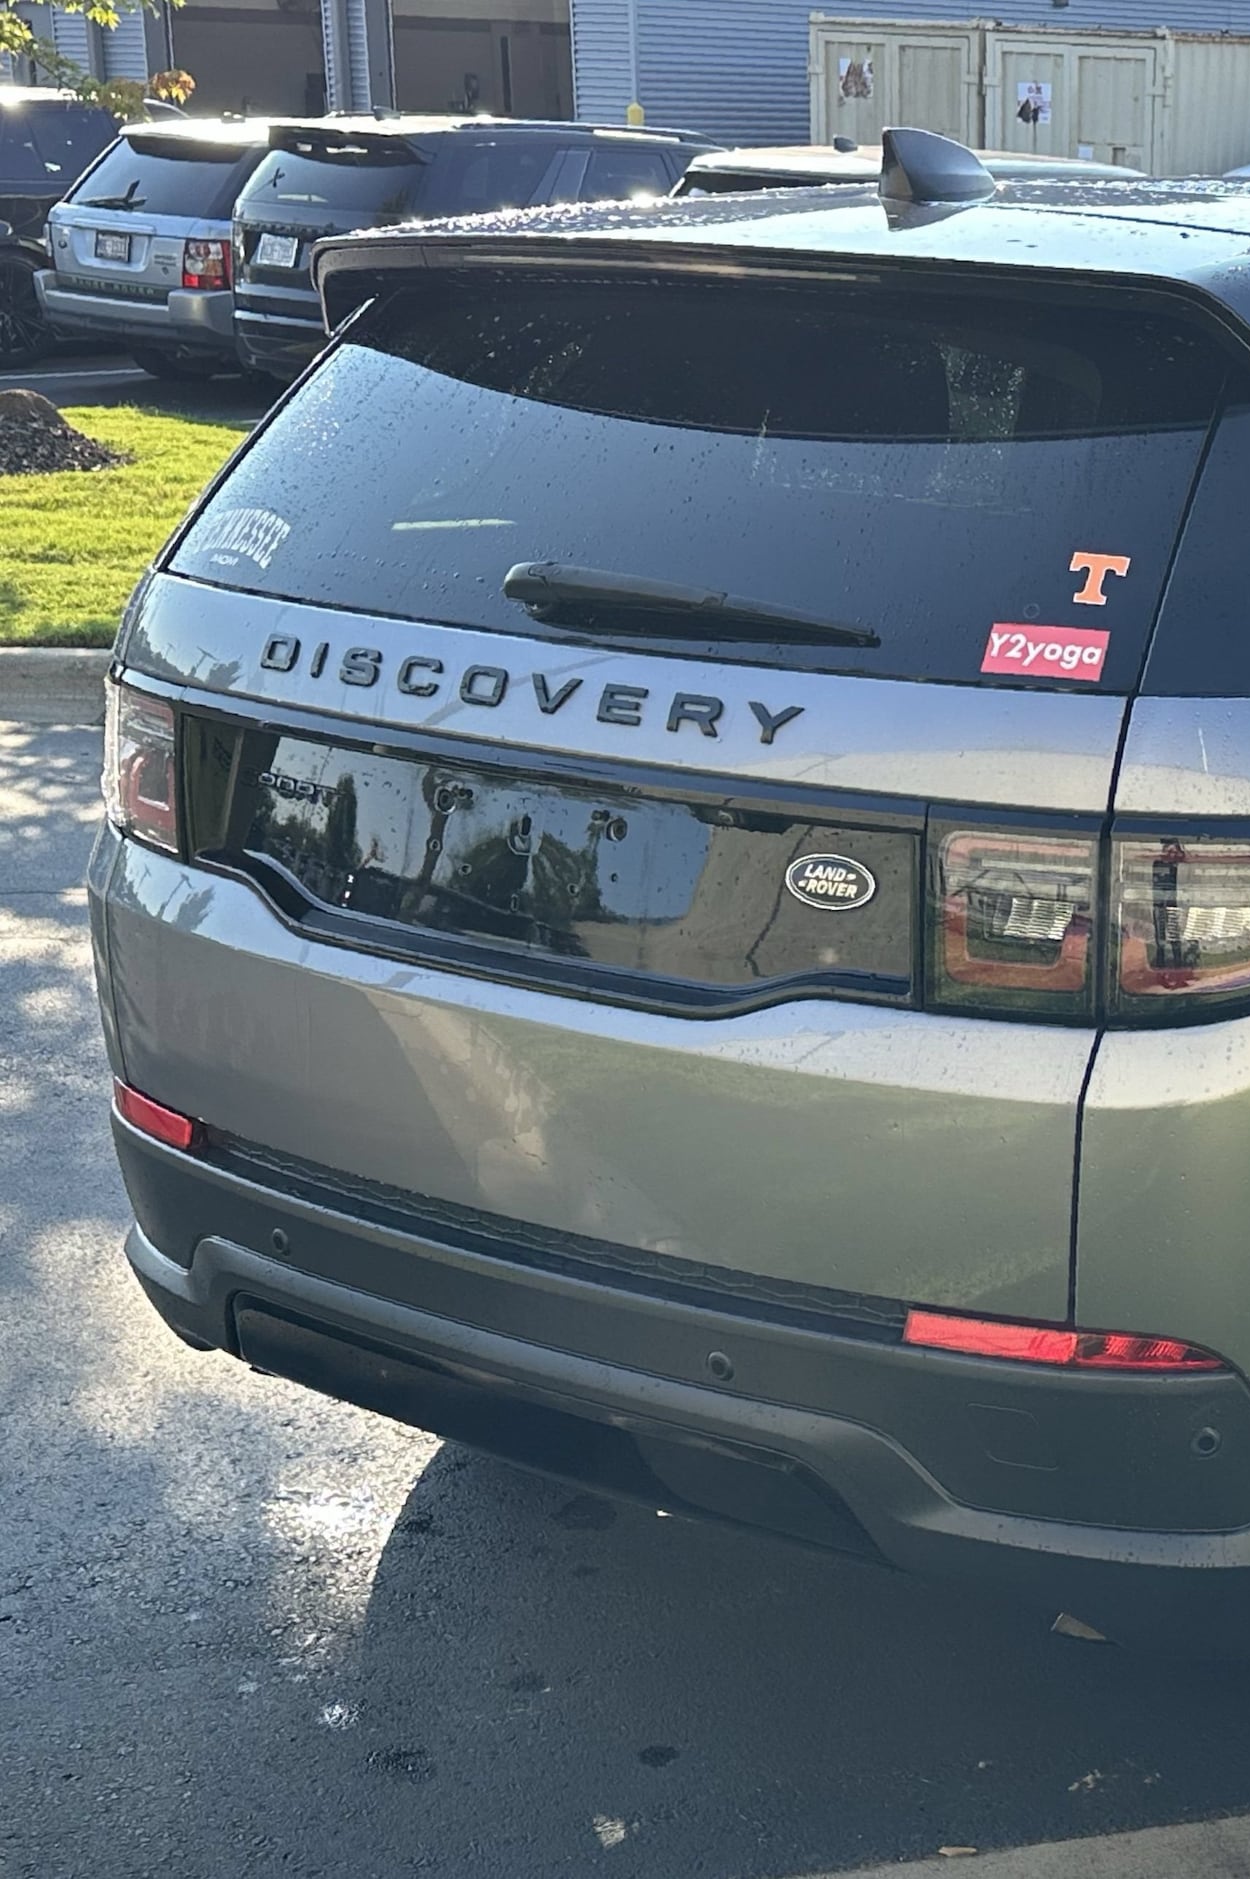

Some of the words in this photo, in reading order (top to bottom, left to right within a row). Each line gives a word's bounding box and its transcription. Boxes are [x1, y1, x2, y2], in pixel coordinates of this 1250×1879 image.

[1069, 551, 1131, 606] T
[990, 631, 1102, 670] Y2yoga
[260, 632, 804, 745] DISCOVERY
[804, 863, 848, 882] LAND
[806, 878, 858, 898] ROVER
